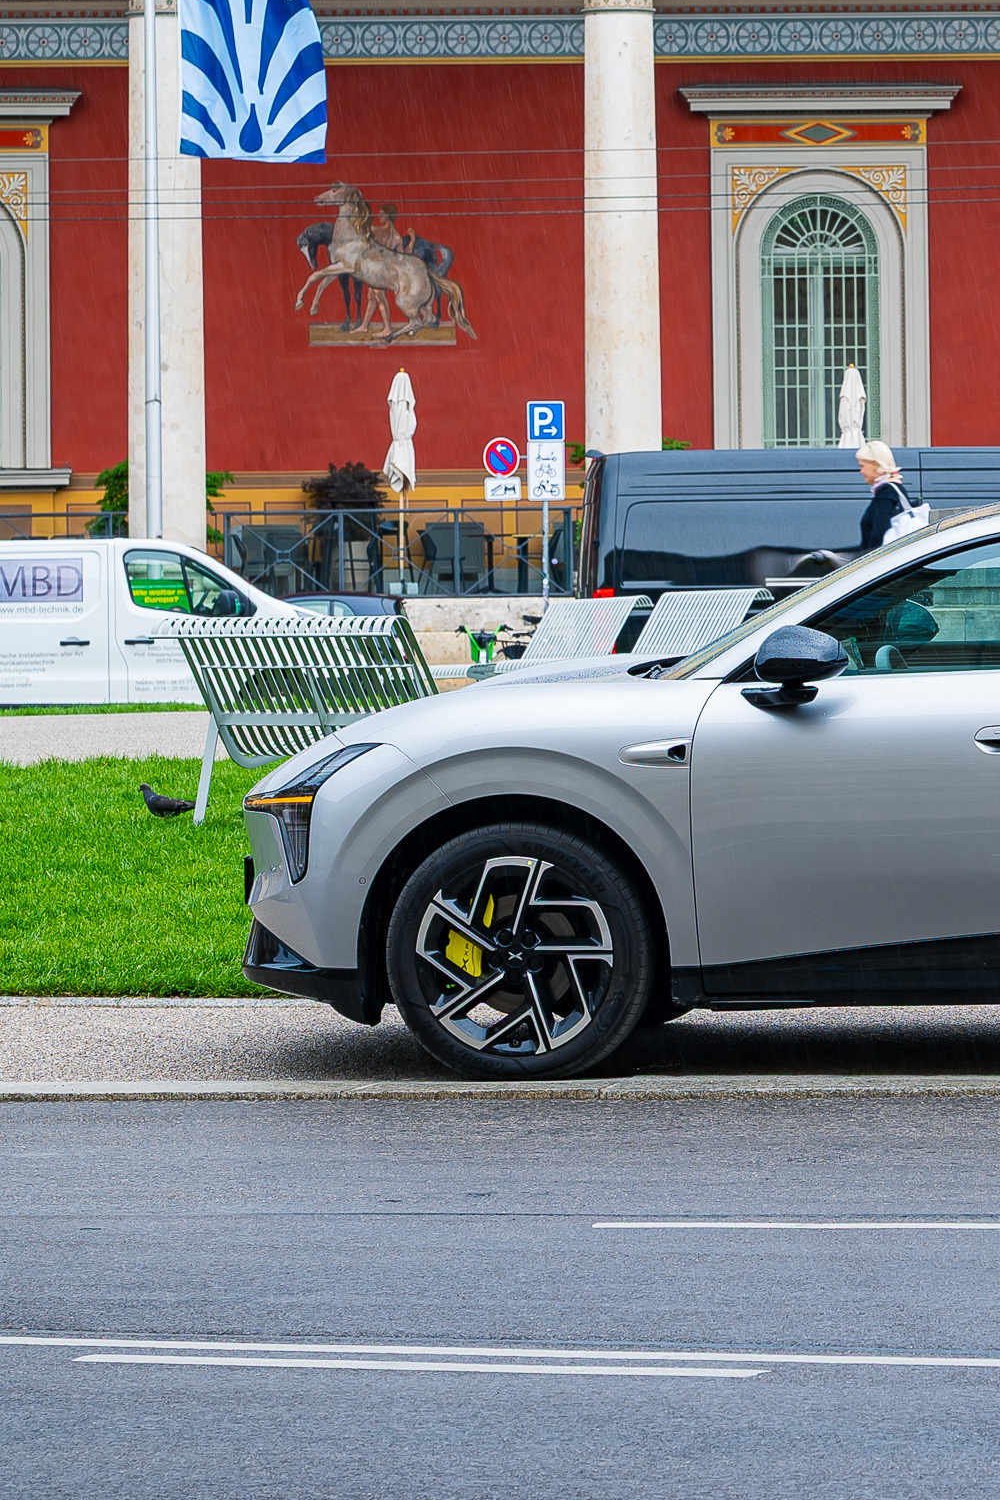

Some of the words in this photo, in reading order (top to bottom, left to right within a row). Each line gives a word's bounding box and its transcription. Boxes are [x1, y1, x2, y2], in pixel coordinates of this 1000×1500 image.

[533, 406, 554, 437] P
[0, 565, 83, 597] MBD
[144, 595, 179, 604] Europa?
